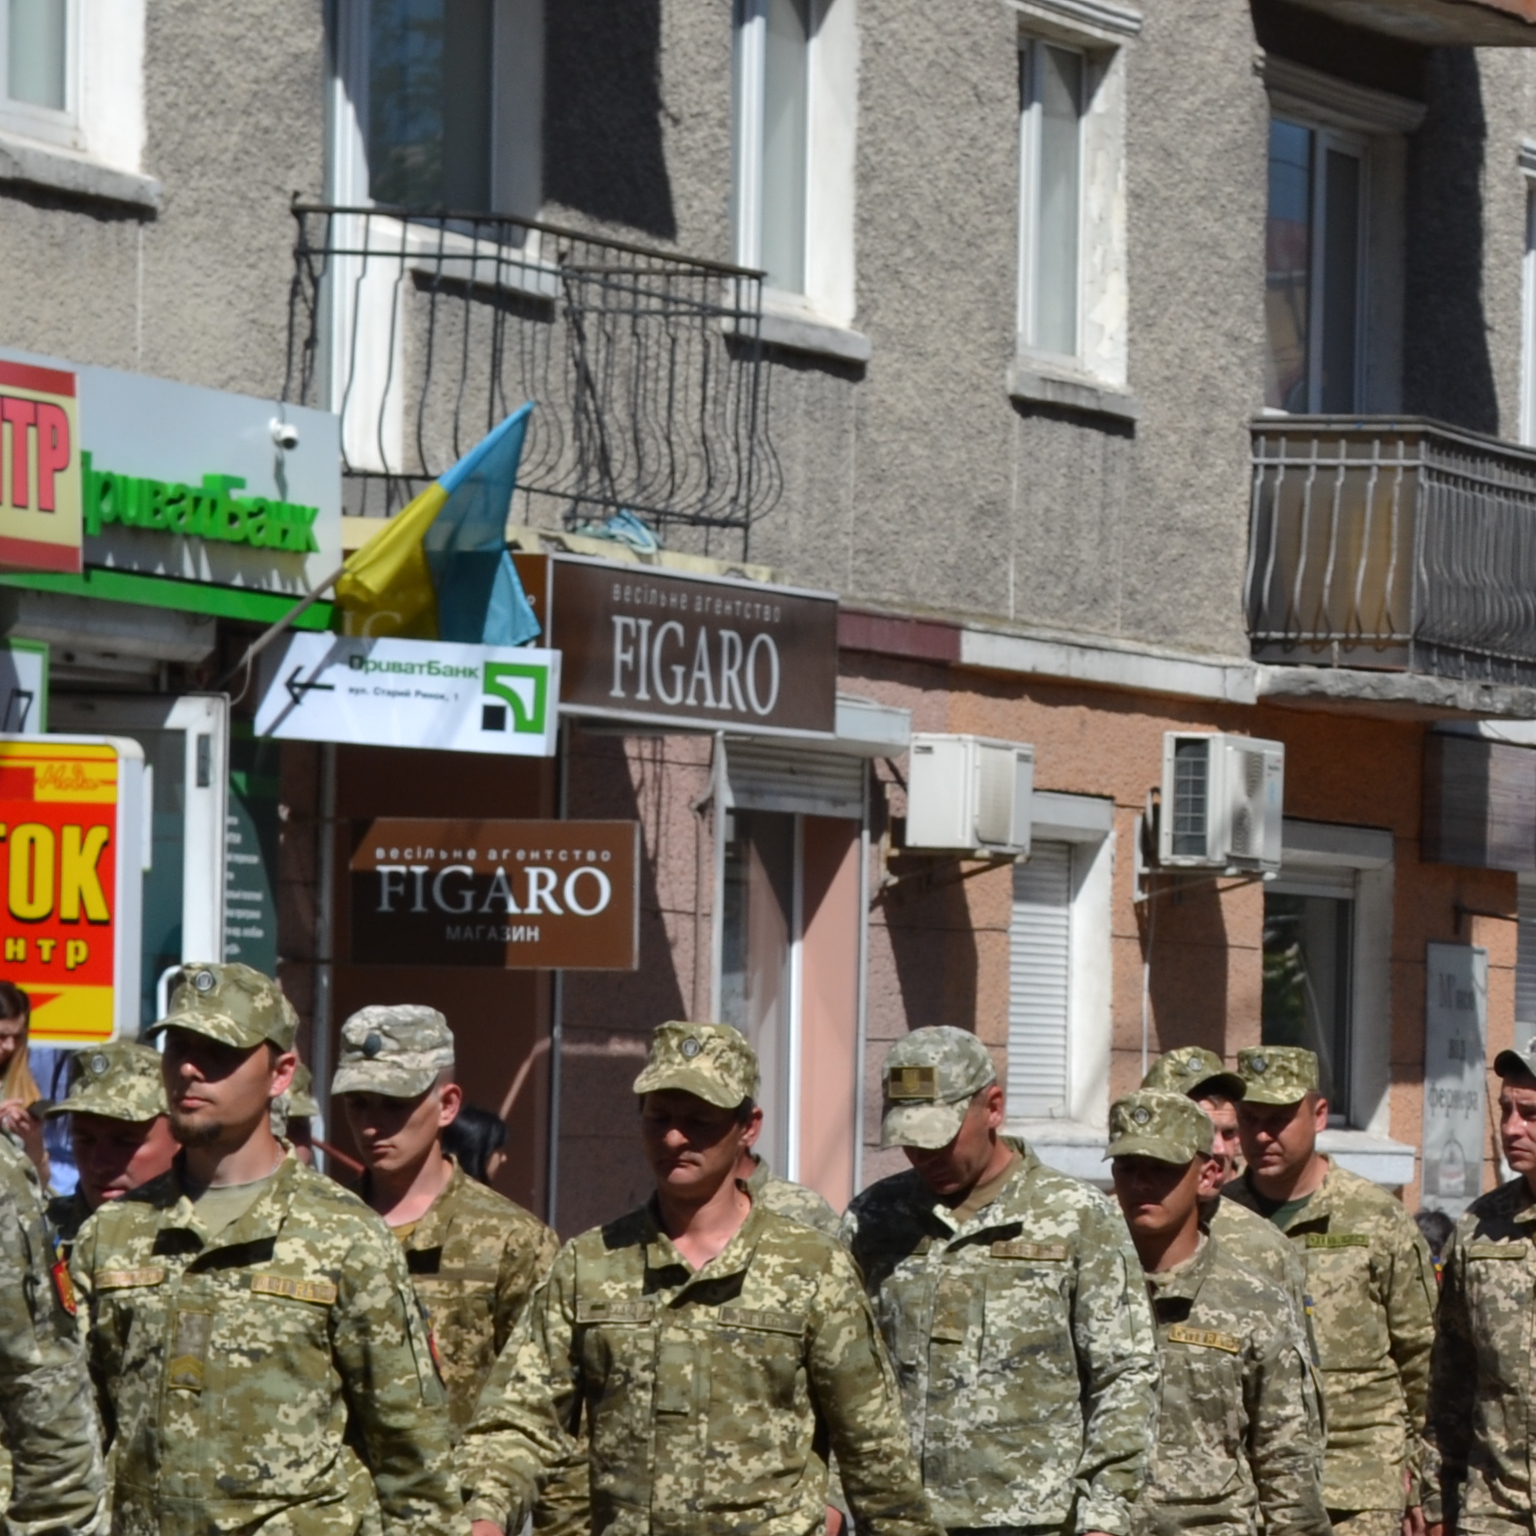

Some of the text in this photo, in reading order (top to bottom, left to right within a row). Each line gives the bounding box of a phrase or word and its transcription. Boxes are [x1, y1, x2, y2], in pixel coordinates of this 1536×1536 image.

[0, 394, 70, 512] ТР
[612, 583, 781, 623] весільне агентство
[350, 654, 481, 680] ПриватБанк
[609, 615, 780, 716] FIGARO
[375, 845, 612, 862] весільне агентство
[375, 864, 612, 917] FIGARO
[445, 925, 540, 942] МАГАЗИН
